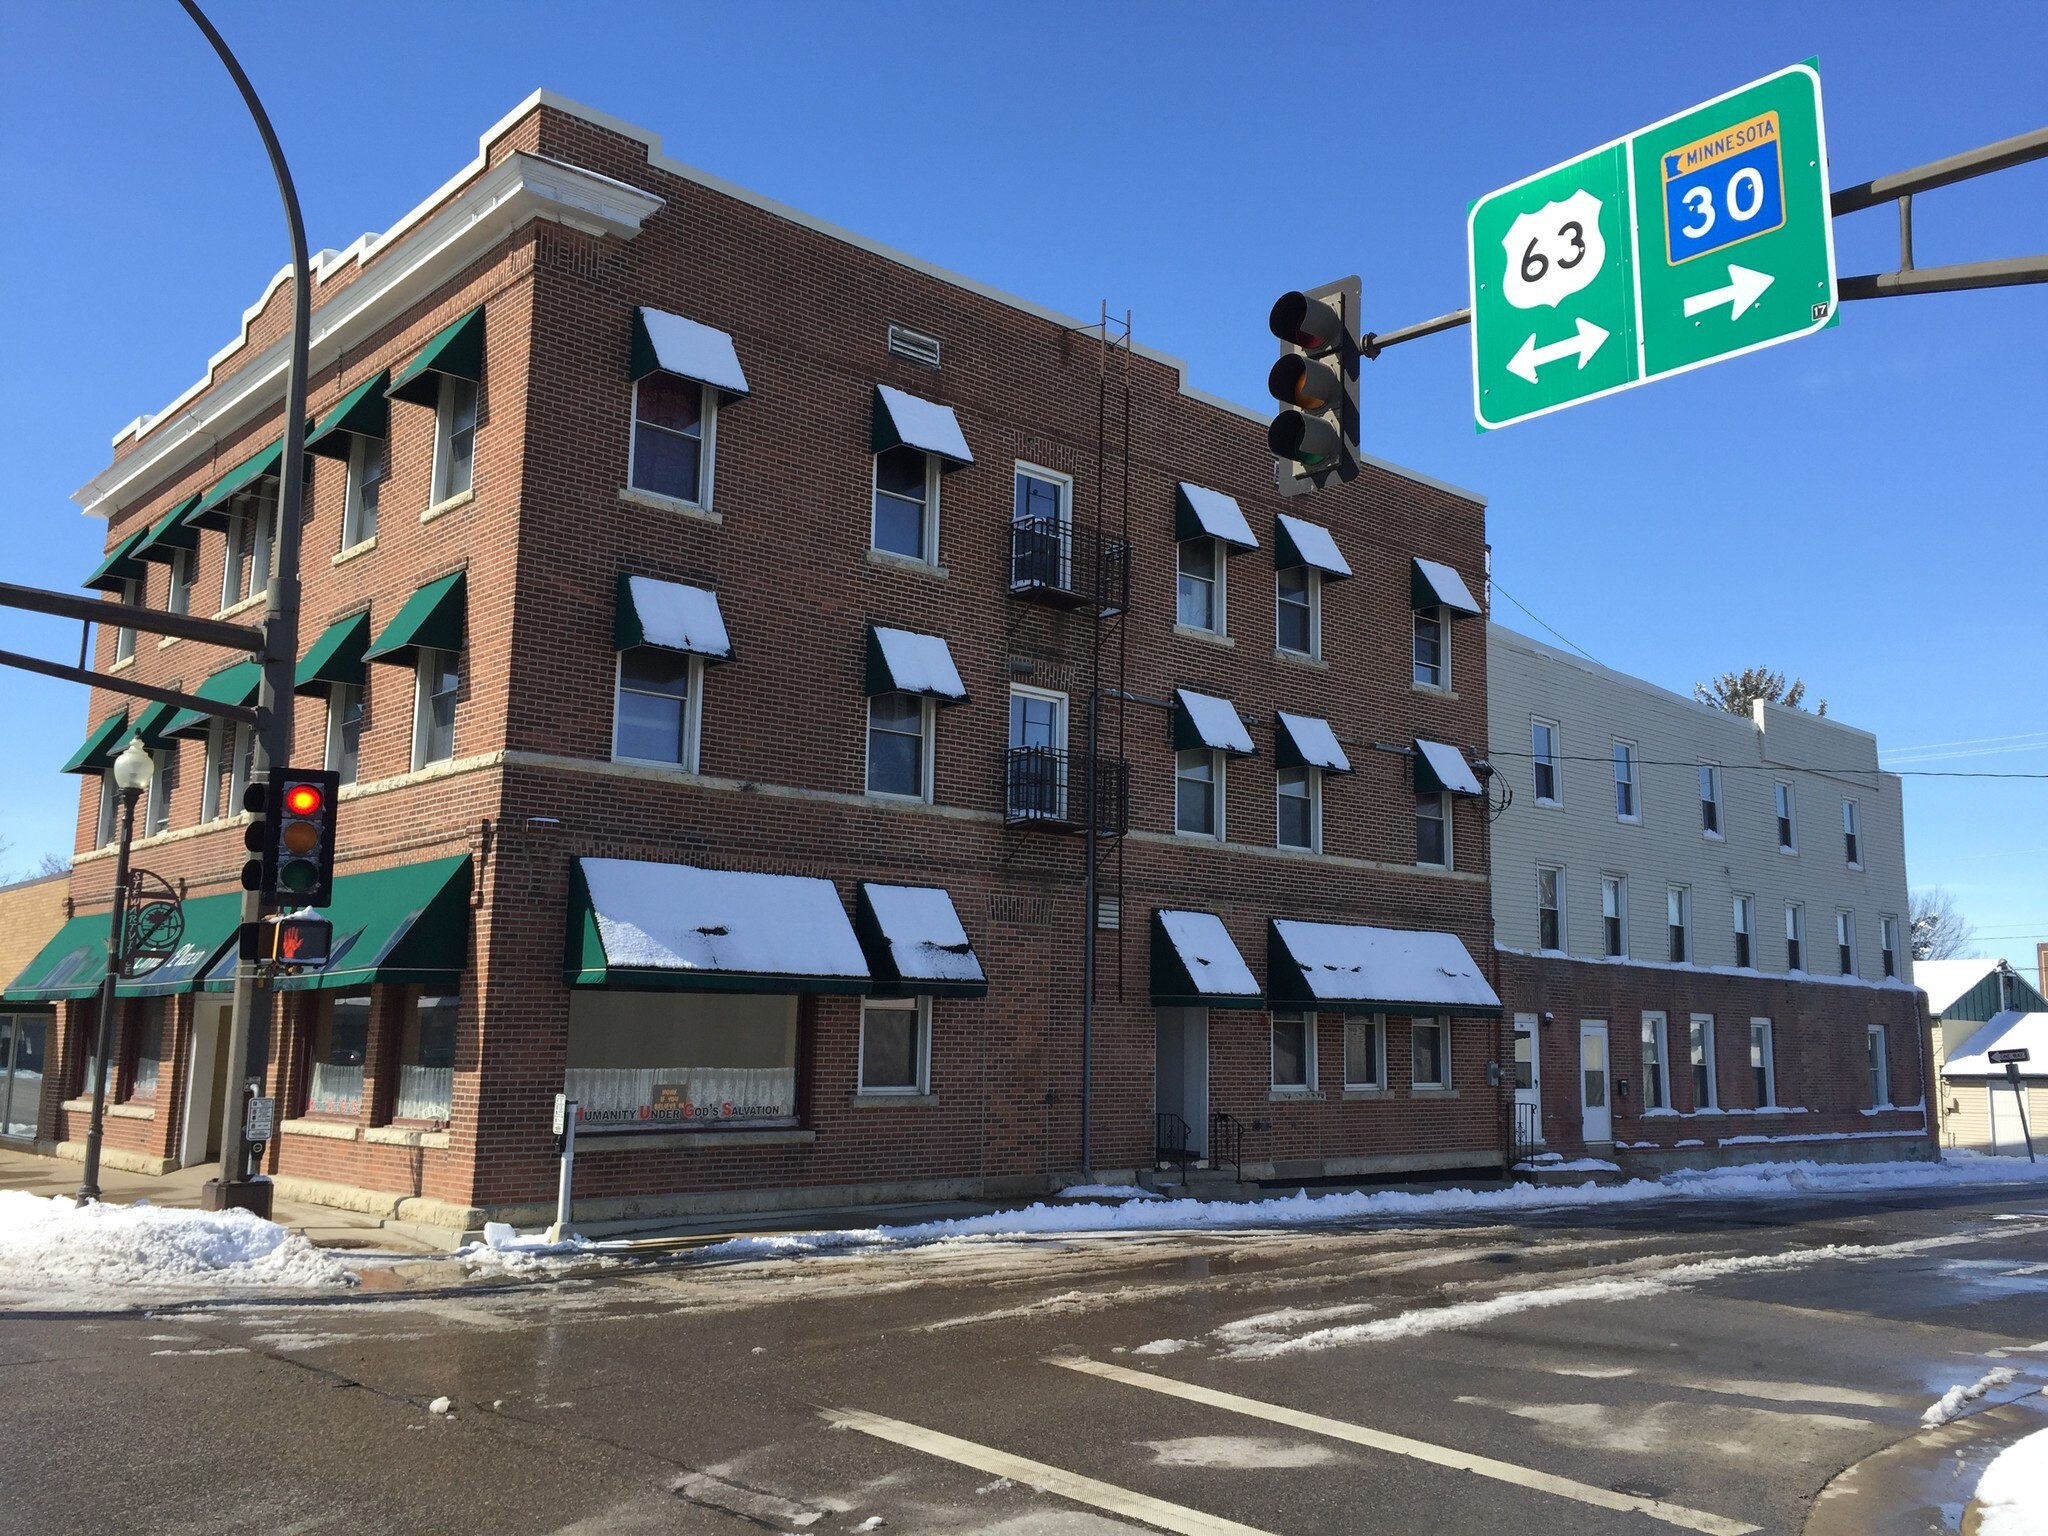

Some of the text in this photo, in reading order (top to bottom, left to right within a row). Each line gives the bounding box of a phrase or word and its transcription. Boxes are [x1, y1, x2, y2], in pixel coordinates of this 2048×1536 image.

[1686, 119, 1775, 167] MINNESOTA
[1681, 166, 1765, 239] 30
[1520, 220, 1586, 283] 63
[1813, 304, 1827, 317] 17
[639, 1105, 680, 1120] UNDER
[683, 1103, 719, 1118] GOD'S
[722, 1101, 780, 1117] SALVATION
